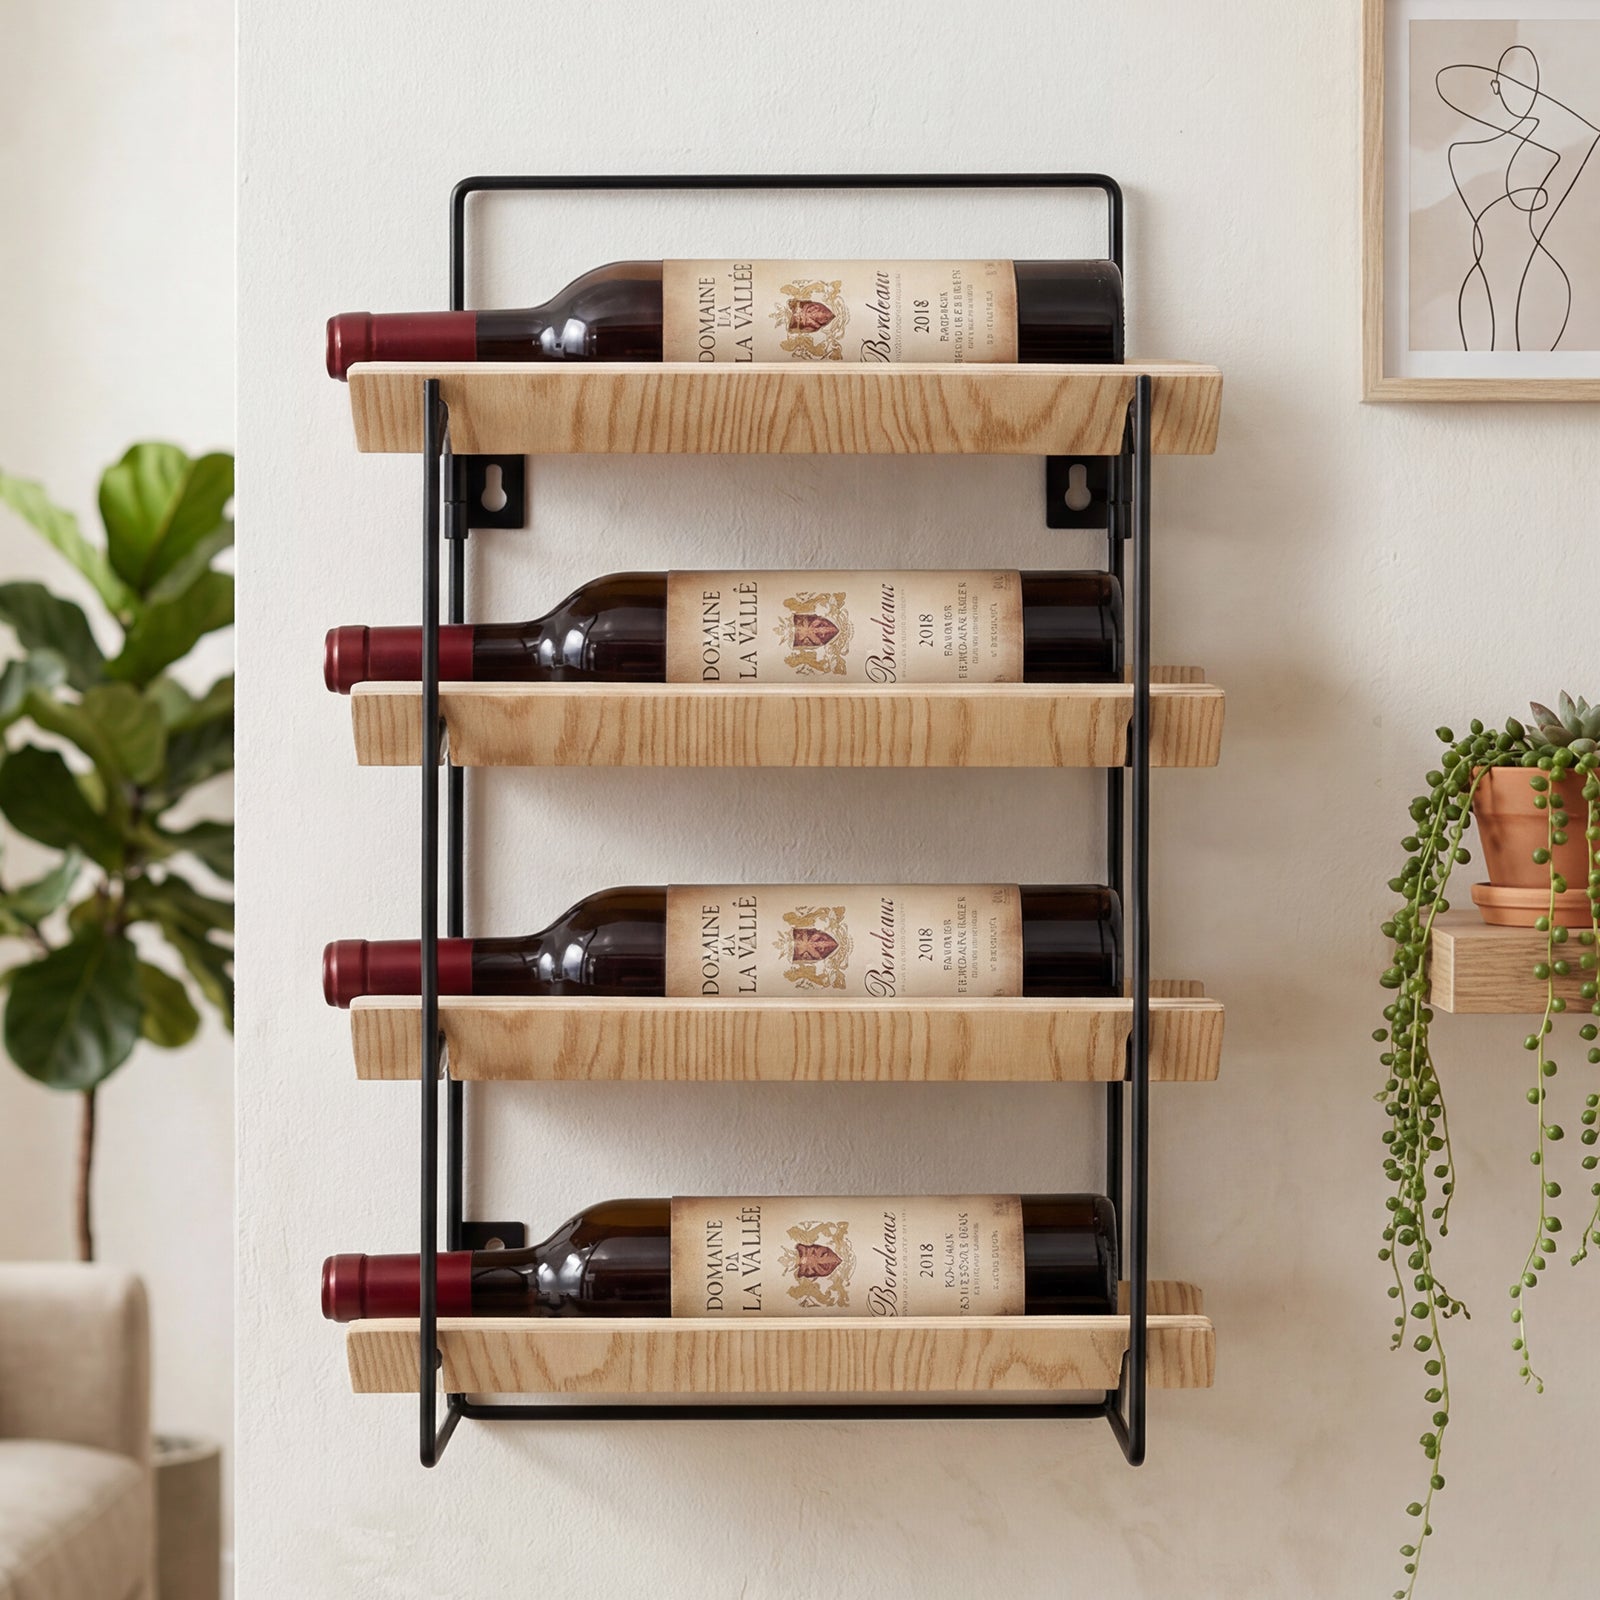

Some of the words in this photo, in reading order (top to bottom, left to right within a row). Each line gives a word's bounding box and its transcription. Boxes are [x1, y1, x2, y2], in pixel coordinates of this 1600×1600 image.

[728, 264, 752, 329] VALLÉE
[699, 278, 715, 362] DOMAINE
[913, 300, 930, 333] 2018
[735, 336, 752, 362] LA
[702, 591, 720, 681] DOMAINE
[919, 614, 934, 647] 2018
[740, 651, 757, 678] LA
[702, 905, 719, 995] DOMAINE
[918, 928, 933, 961] 2018
[739, 965, 757, 992] LA
[736, 1206, 761, 1276] VALLÉE
[707, 1220, 723, 1311] DOMAINE
[920, 1243, 934, 1278] 2018
[742, 1283, 761, 1311] LA
